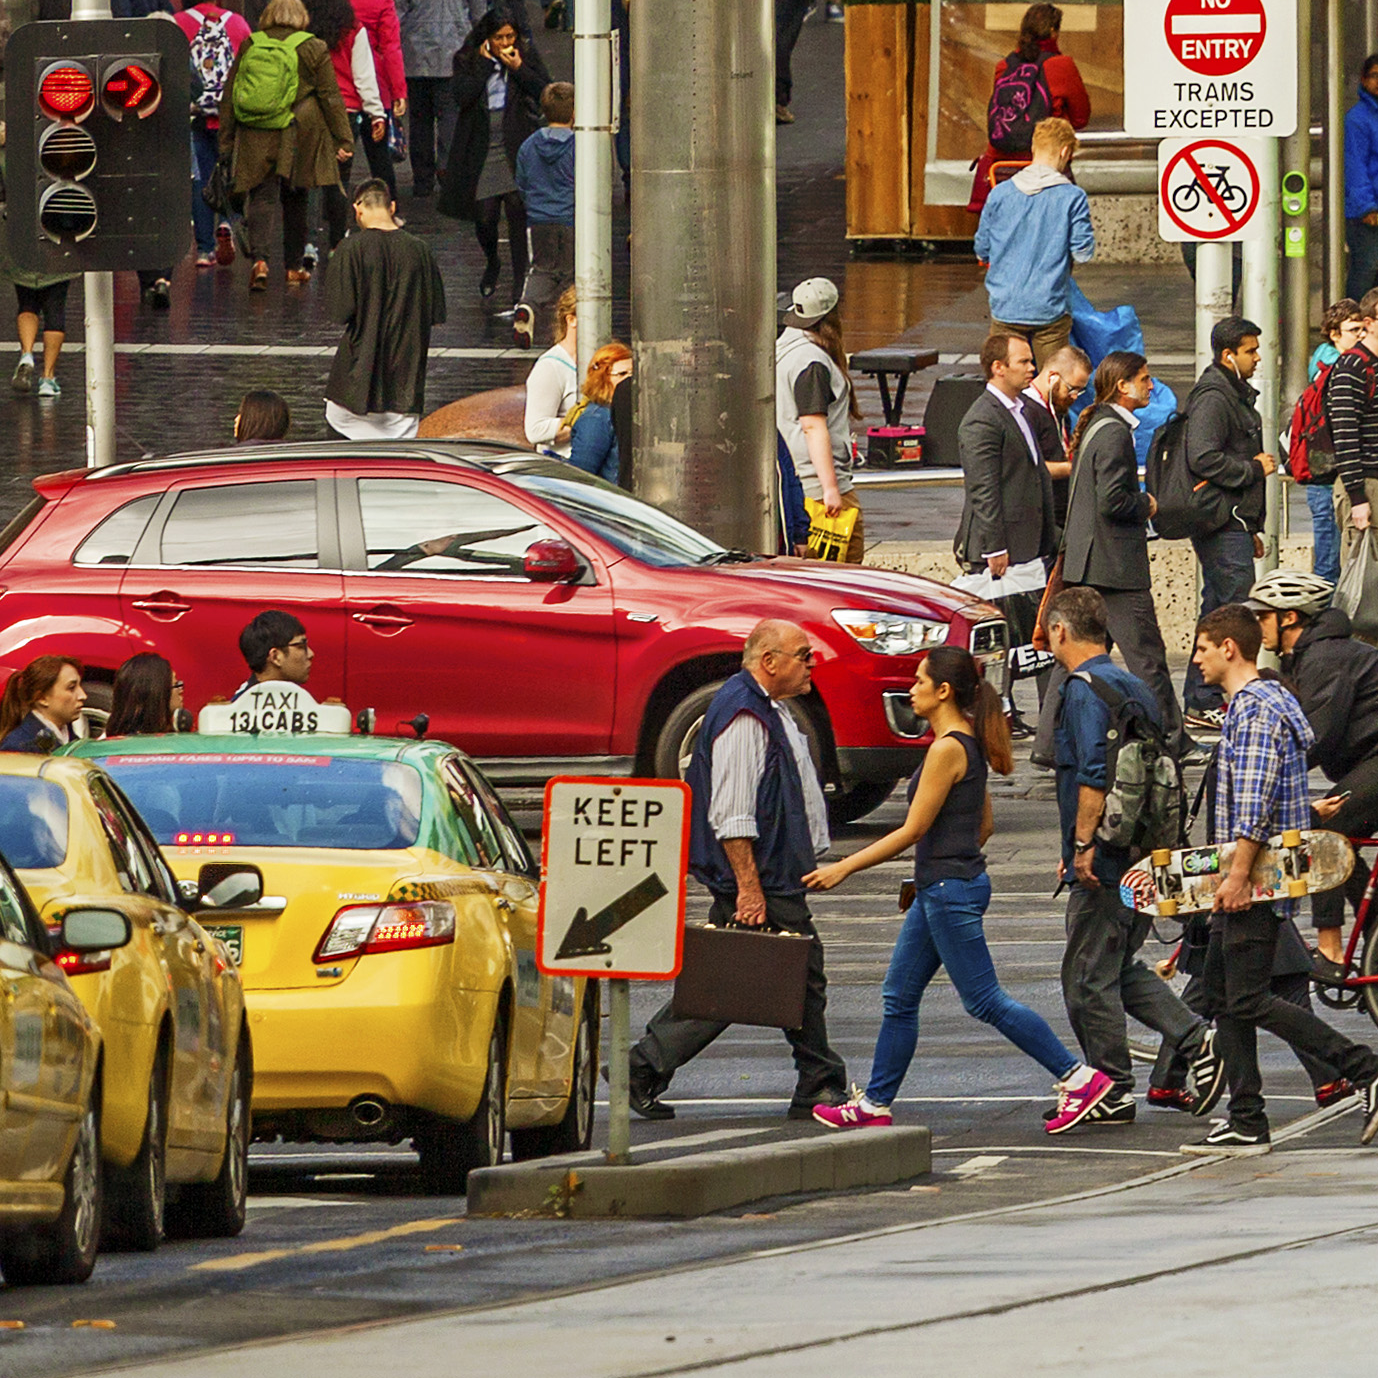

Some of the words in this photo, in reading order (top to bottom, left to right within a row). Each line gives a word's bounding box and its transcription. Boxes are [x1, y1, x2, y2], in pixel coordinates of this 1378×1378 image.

[1181, 38, 1253, 60] ENTRY
[1174, 82, 1254, 102] TRAMS
[1154, 108, 1273, 129] EXCEPTED
[251, 692, 298, 710] TAXI
[574, 797, 663, 828] KEEP
[575, 837, 658, 868] LEFT
